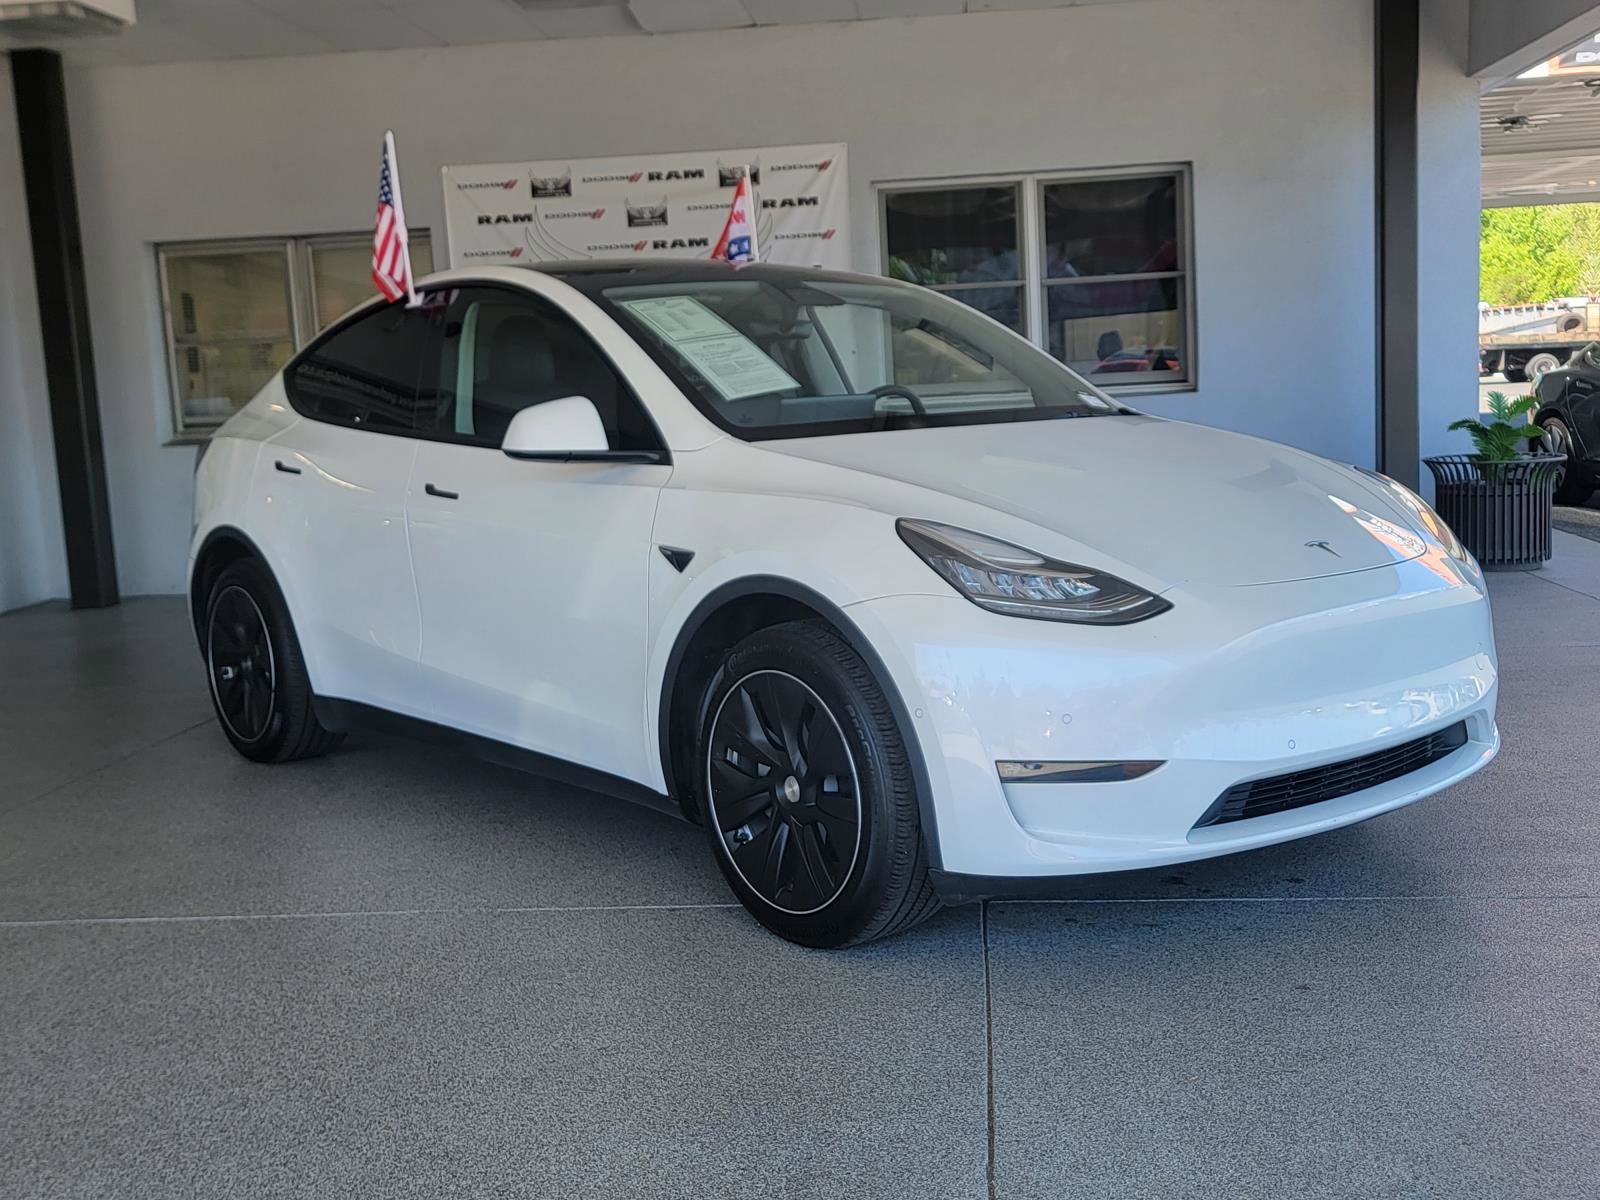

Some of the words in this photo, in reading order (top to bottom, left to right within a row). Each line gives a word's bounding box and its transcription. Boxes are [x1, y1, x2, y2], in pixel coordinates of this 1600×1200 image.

[648, 168, 704, 182] RAM
[762, 197, 818, 209] RAM
[477, 213, 533, 226] RAM
[652, 237, 709, 250] RAM
